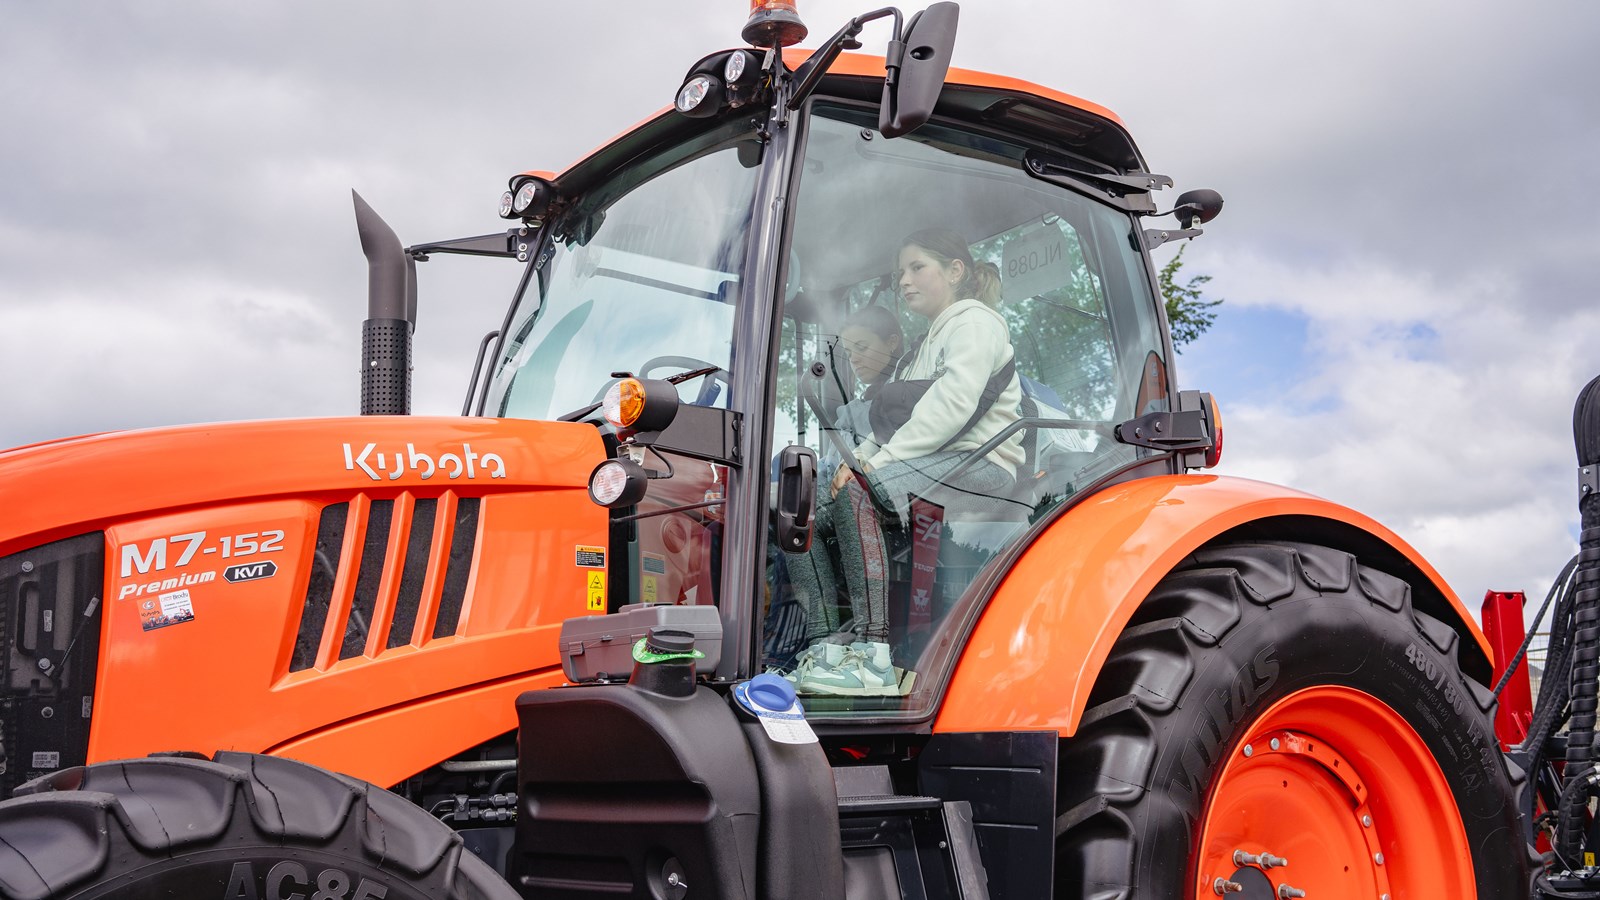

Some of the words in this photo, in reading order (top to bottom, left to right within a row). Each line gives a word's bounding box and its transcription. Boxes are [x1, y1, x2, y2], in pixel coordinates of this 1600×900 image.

[343, 443, 506, 480] Kubota
[120, 530, 285, 578] M7-152
[118, 571, 217, 600] Premium
[234, 564, 267, 579] KVT
